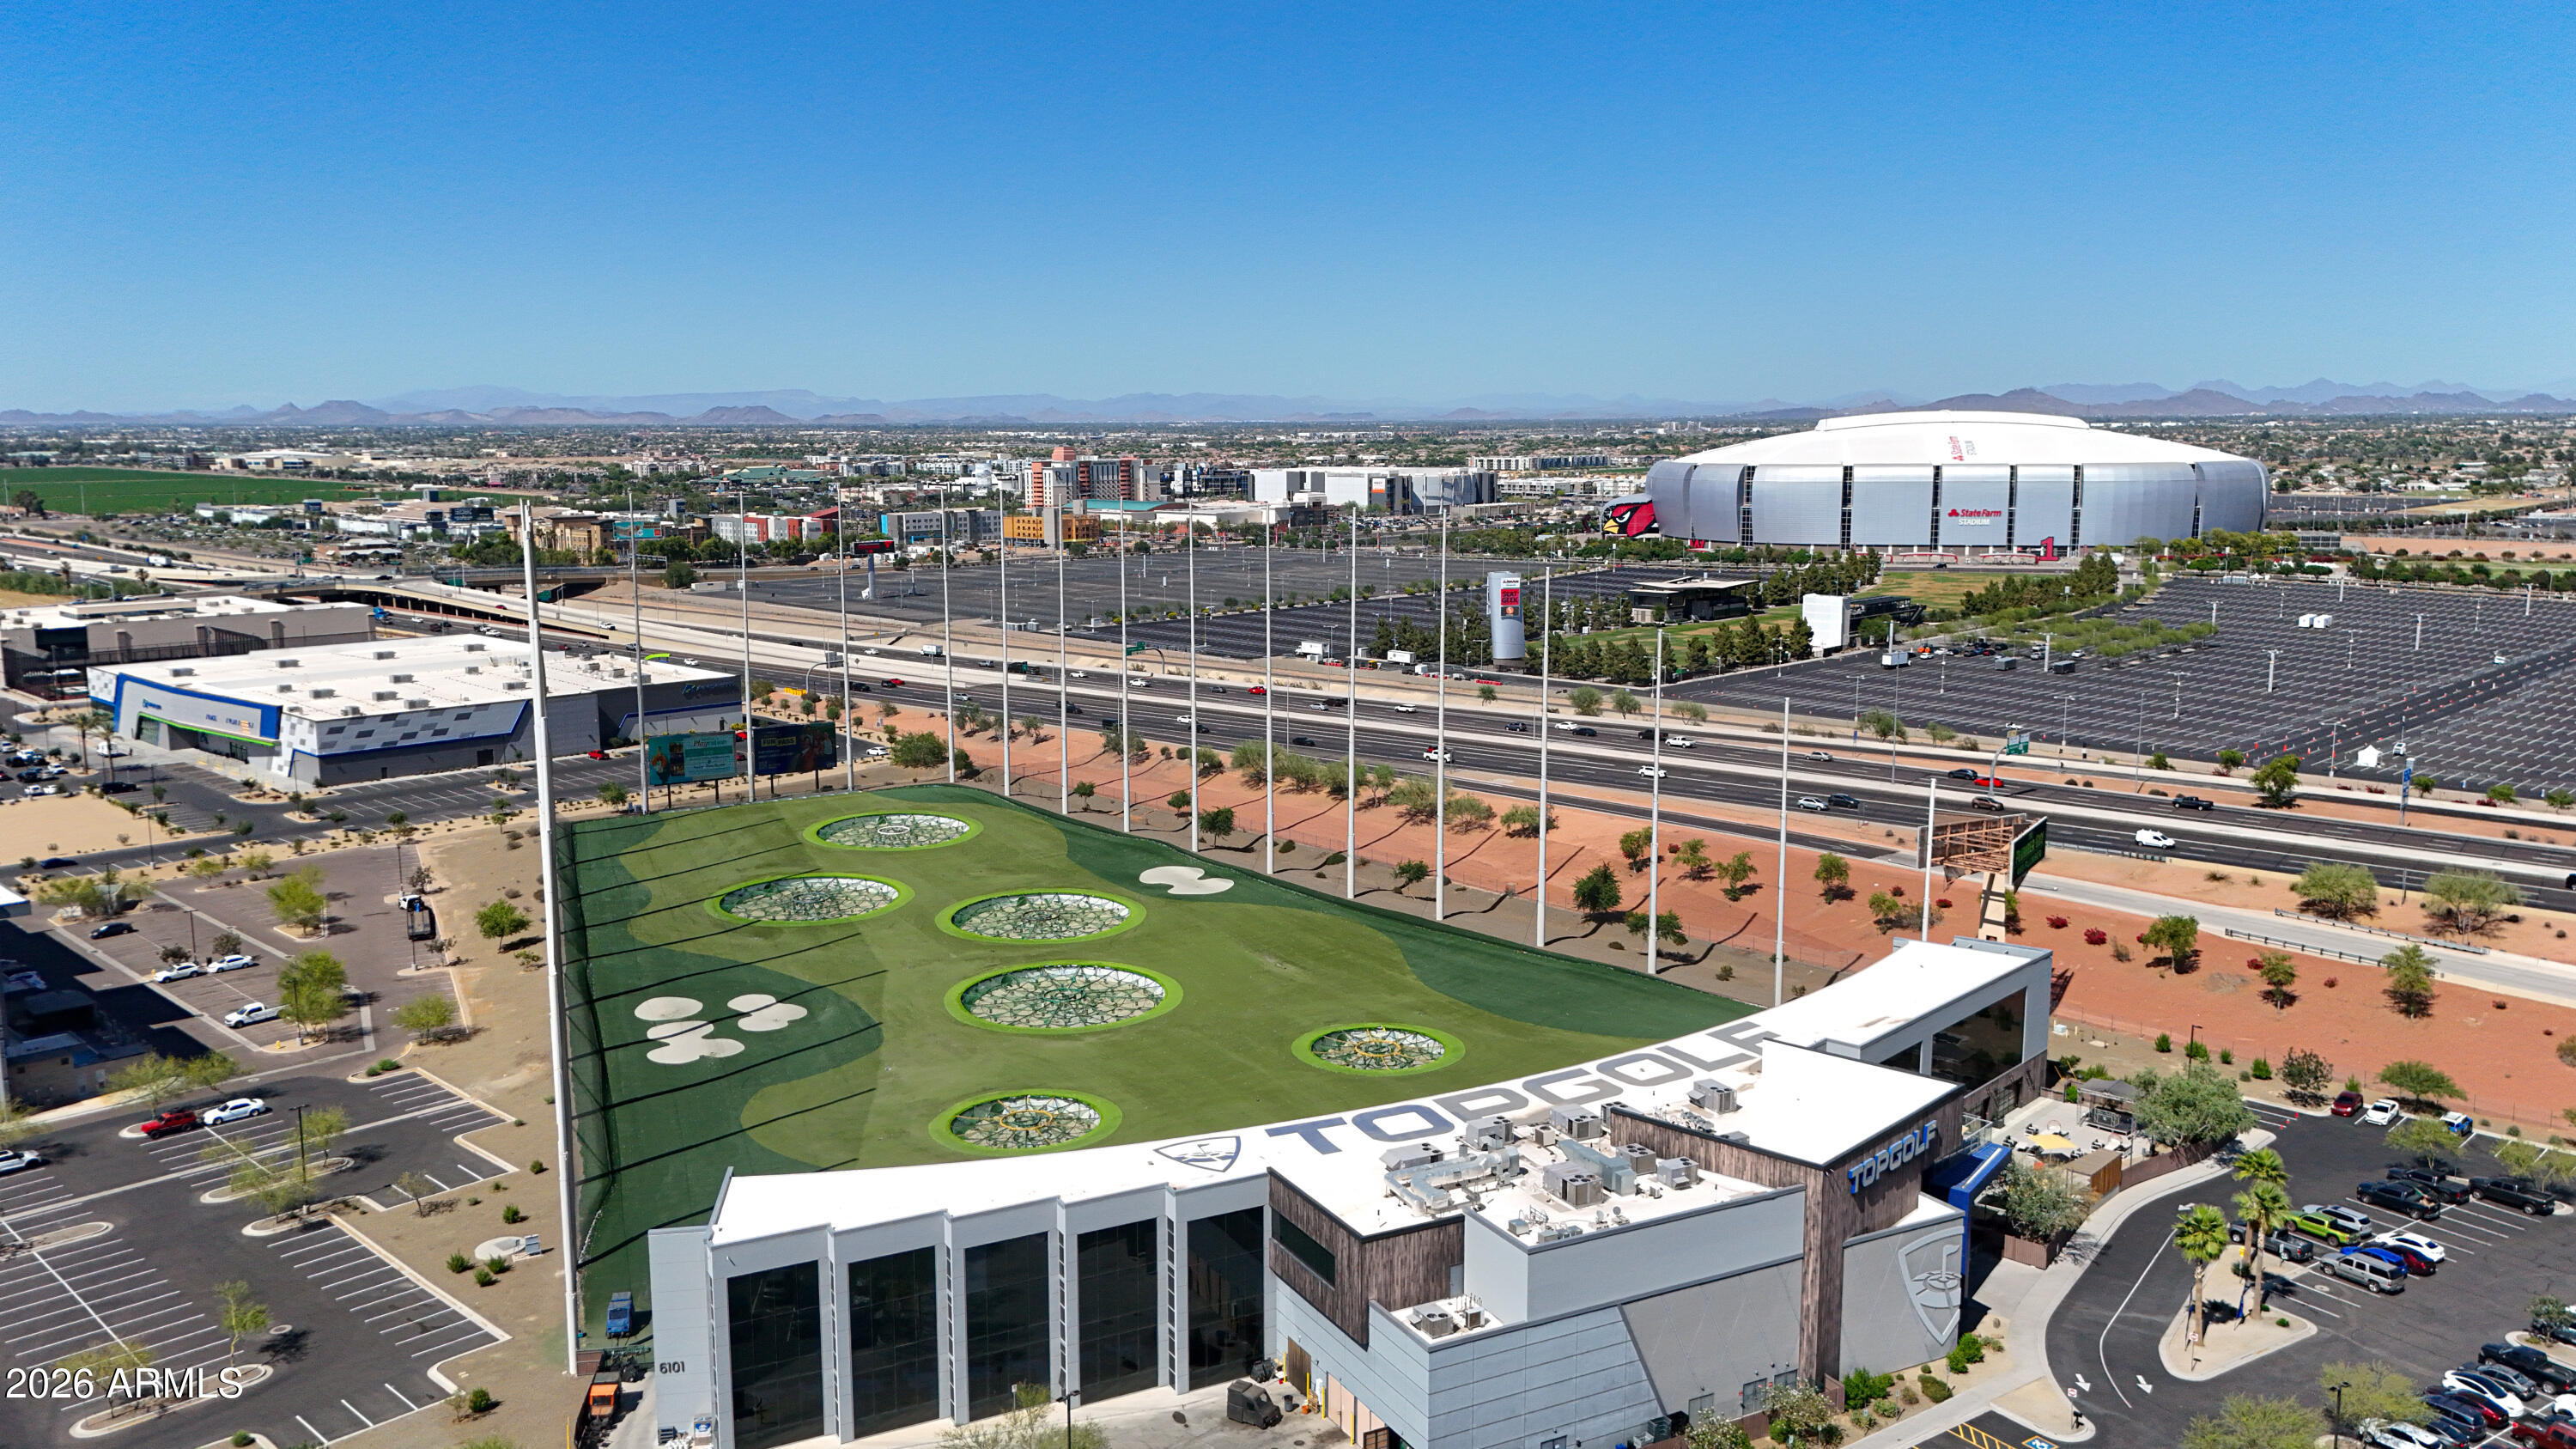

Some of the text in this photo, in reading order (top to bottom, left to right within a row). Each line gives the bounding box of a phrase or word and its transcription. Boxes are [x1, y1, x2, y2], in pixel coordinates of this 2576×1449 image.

[1055, 470, 1063, 481] R
[2040, 536, 2059, 561] 1
[1266, 1020, 1782, 1155] TOPGOLF
[1848, 1120, 1937, 1194] TOPGOLF
[659, 1361, 685, 1374] 6101
